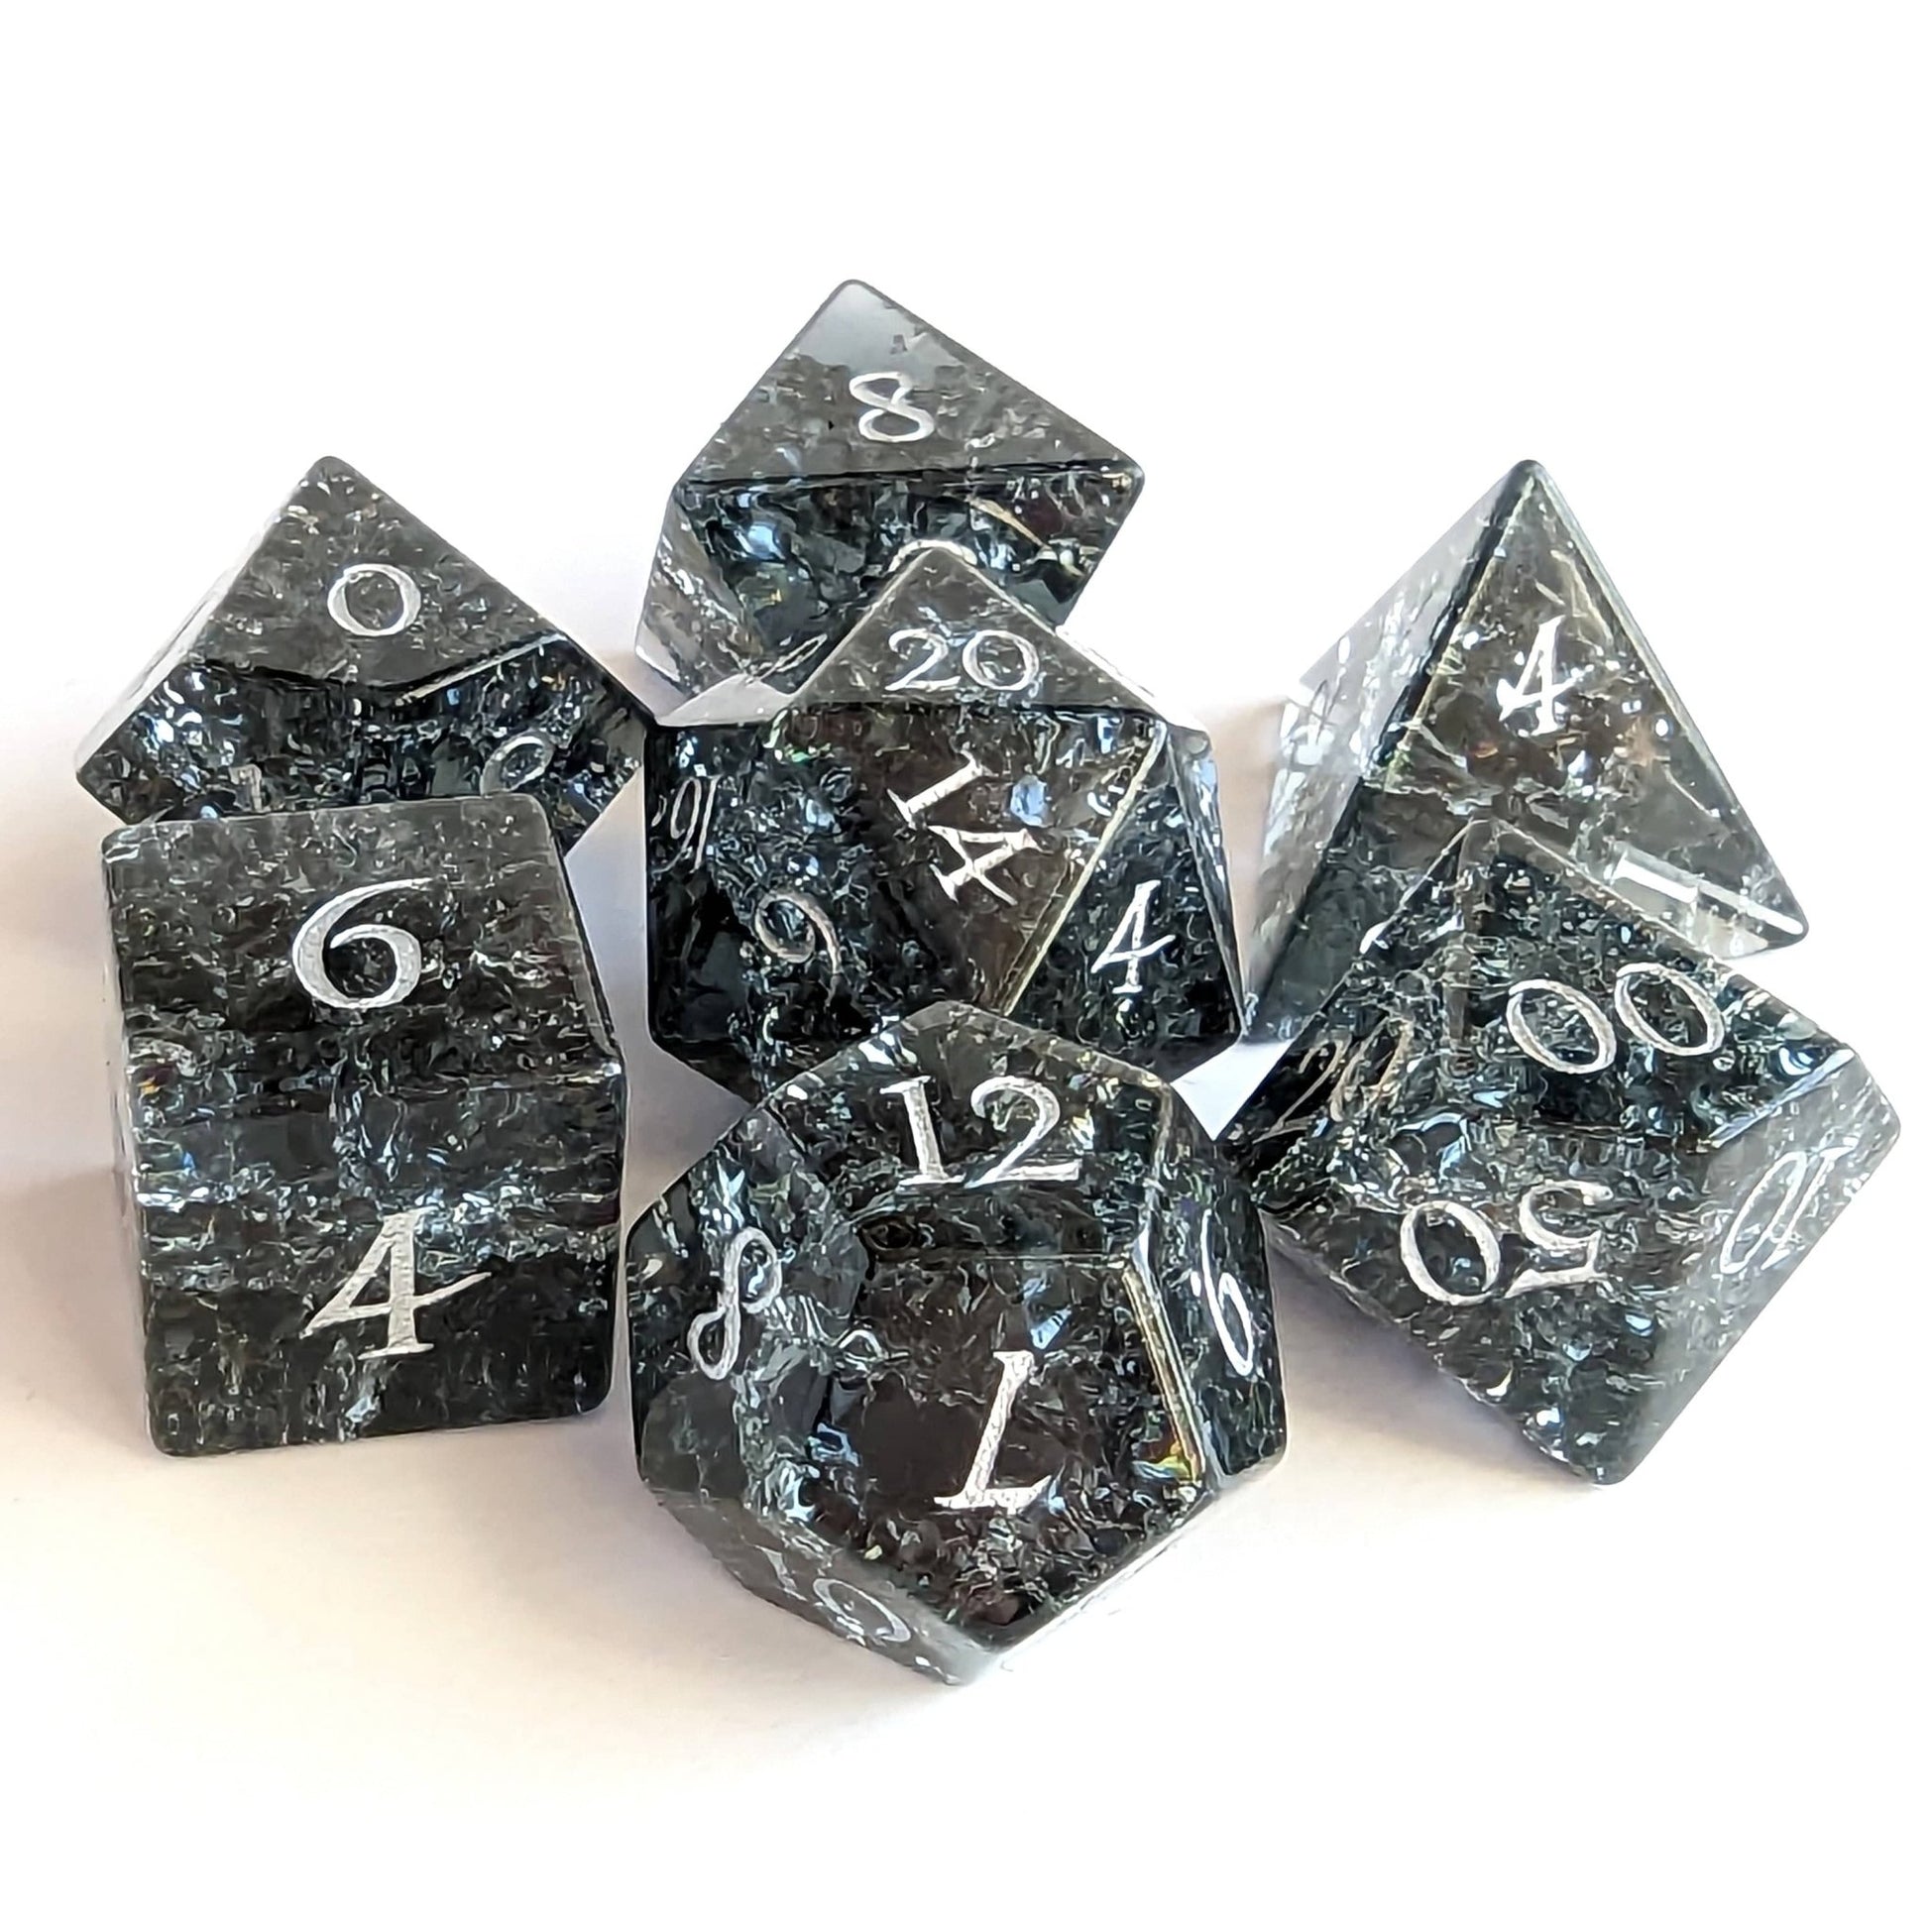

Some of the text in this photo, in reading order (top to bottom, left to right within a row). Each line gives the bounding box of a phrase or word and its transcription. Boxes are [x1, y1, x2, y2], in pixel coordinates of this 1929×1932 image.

[850, 371, 936, 443] 8
[327, 563, 422, 637] 0
[884, 627, 1040, 693] 20
[1496, 614, 1592, 738] 4
[886, 749, 1053, 905] 14
[291, 876, 436, 1011] 6
[1090, 878, 1177, 994] 4
[1506, 962, 1726, 1076] 00
[879, 1075, 1079, 1190] 12
[299, 1205, 493, 1362] 4
[687, 1225, 783, 1381] 8
[1400, 1180, 1613, 1307] 50
